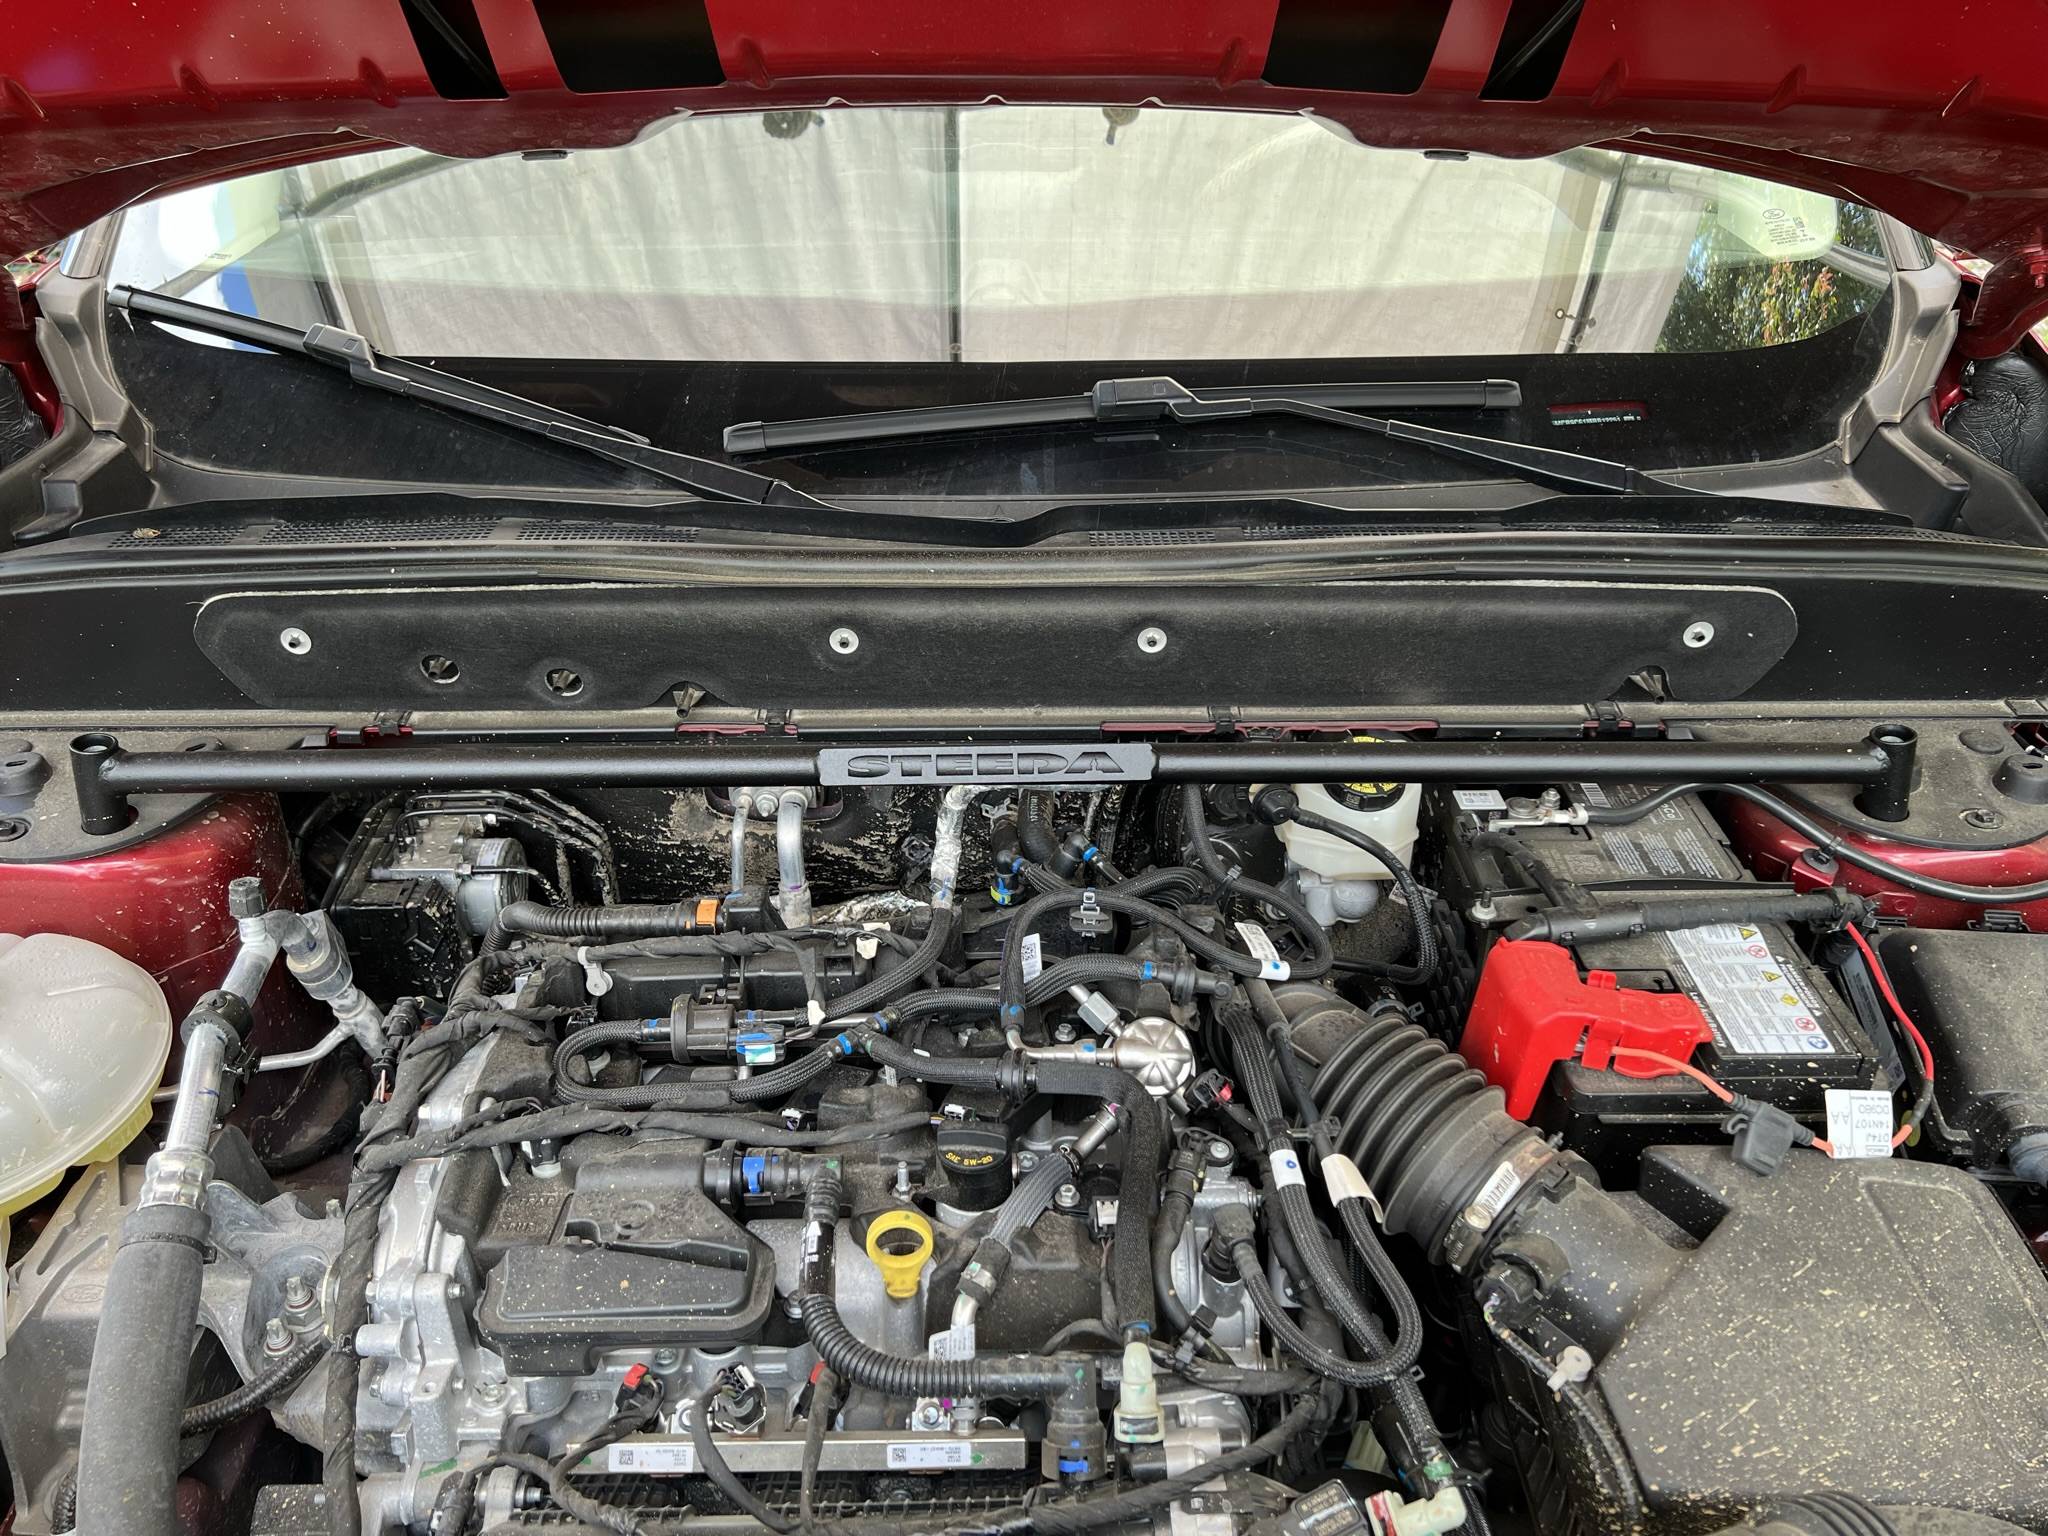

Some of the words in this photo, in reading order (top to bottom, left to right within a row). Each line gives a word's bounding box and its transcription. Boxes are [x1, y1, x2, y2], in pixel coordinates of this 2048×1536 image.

[847, 751, 1125, 778] STEEDA
[945, 1152, 961, 1164] SAE
[963, 1155, 993, 1166] 5W-20
